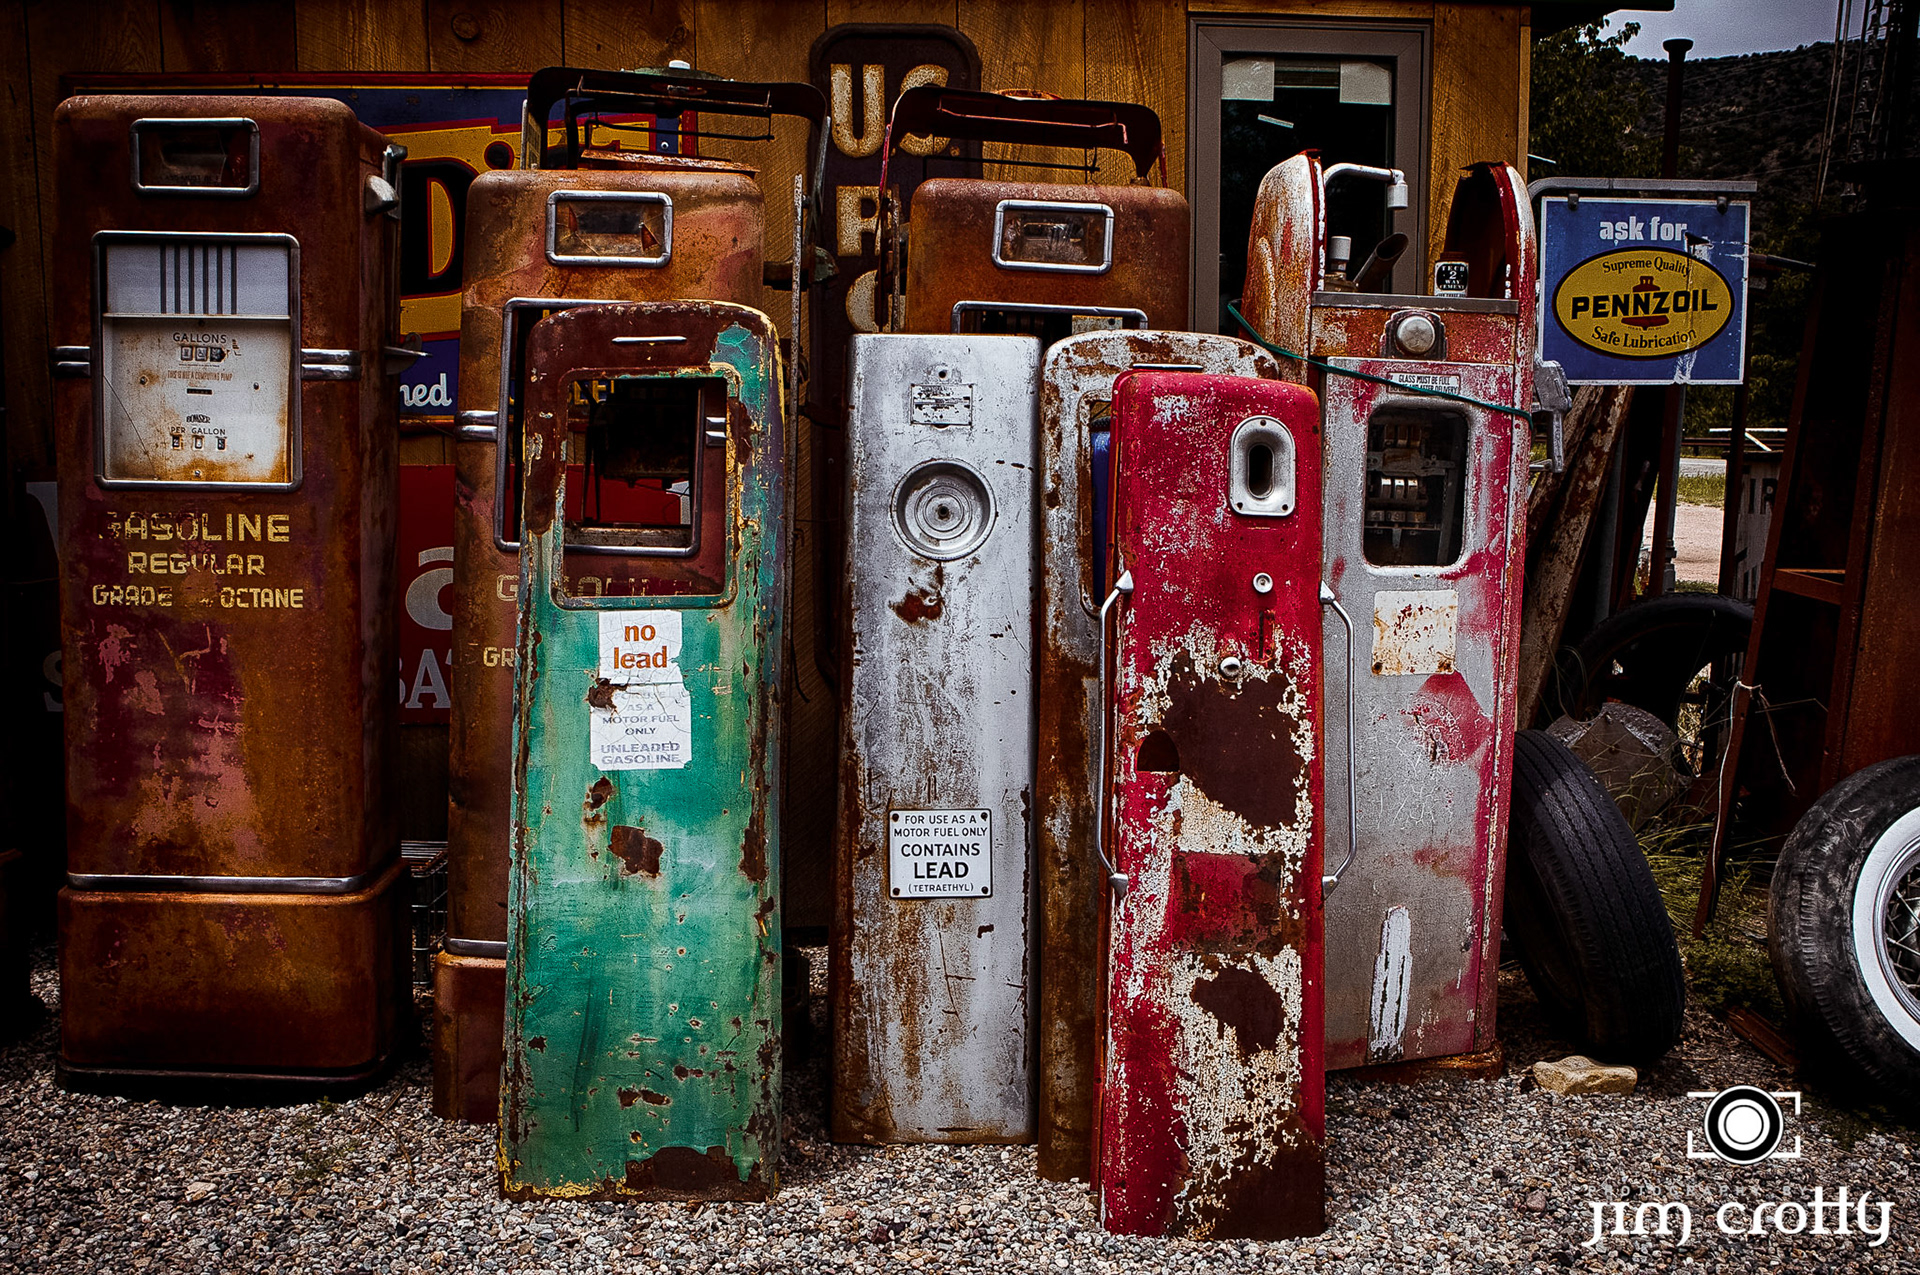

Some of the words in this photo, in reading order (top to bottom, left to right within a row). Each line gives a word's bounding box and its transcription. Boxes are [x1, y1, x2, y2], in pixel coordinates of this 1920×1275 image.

[1599, 215, 1645, 241] ask
[1649, 216, 1688, 241] for
[1602, 259, 1652, 275] Supreme
[1653, 256, 1692, 278] Quality
[1448, 270, 1458, 280] 2
[1571, 289, 1719, 320] PENNZOIL
[172, 332, 228, 344] GALLONS
[1591, 325, 1621, 346] Safe
[1623, 328, 1698, 349] Lubrication
[1398, 374, 1416, 383] GLASS
[1416, 375, 1431, 384] MUST
[1431, 376, 1438, 385] BE
[1438, 377, 1450, 386] FULL
[185, 413, 211, 424] BOWSER
[170, 426, 186, 434] PER
[191, 427, 226, 436] GALLON
[128, 551, 266, 575] REGULAR
[92, 584, 173, 607] GRADE
[220, 587, 304, 609] OCTANE
[624, 624, 657, 642] no
[613, 645, 668, 670] lead
[602, 715, 648, 724] MOTOR
[651, 714, 680, 723] FUEL
[624, 727, 657, 736] ONLY
[600, 741, 681, 754] UNLEADED
[601, 753, 681, 765] GASOLINE
[904, 815, 925, 825] FOR
[928, 815, 949, 825] USE
[951, 814, 966, 824] AS
[969, 814, 977, 824] A
[894, 828, 930, 838] MOTOR
[933, 827, 959, 837] FUEL
[961, 827, 988, 837] ONLY
[901, 842, 981, 857] CONTAINS
[913, 861, 969, 879] LEAD
[908, 882, 974, 894] (TETRAETHYL)
